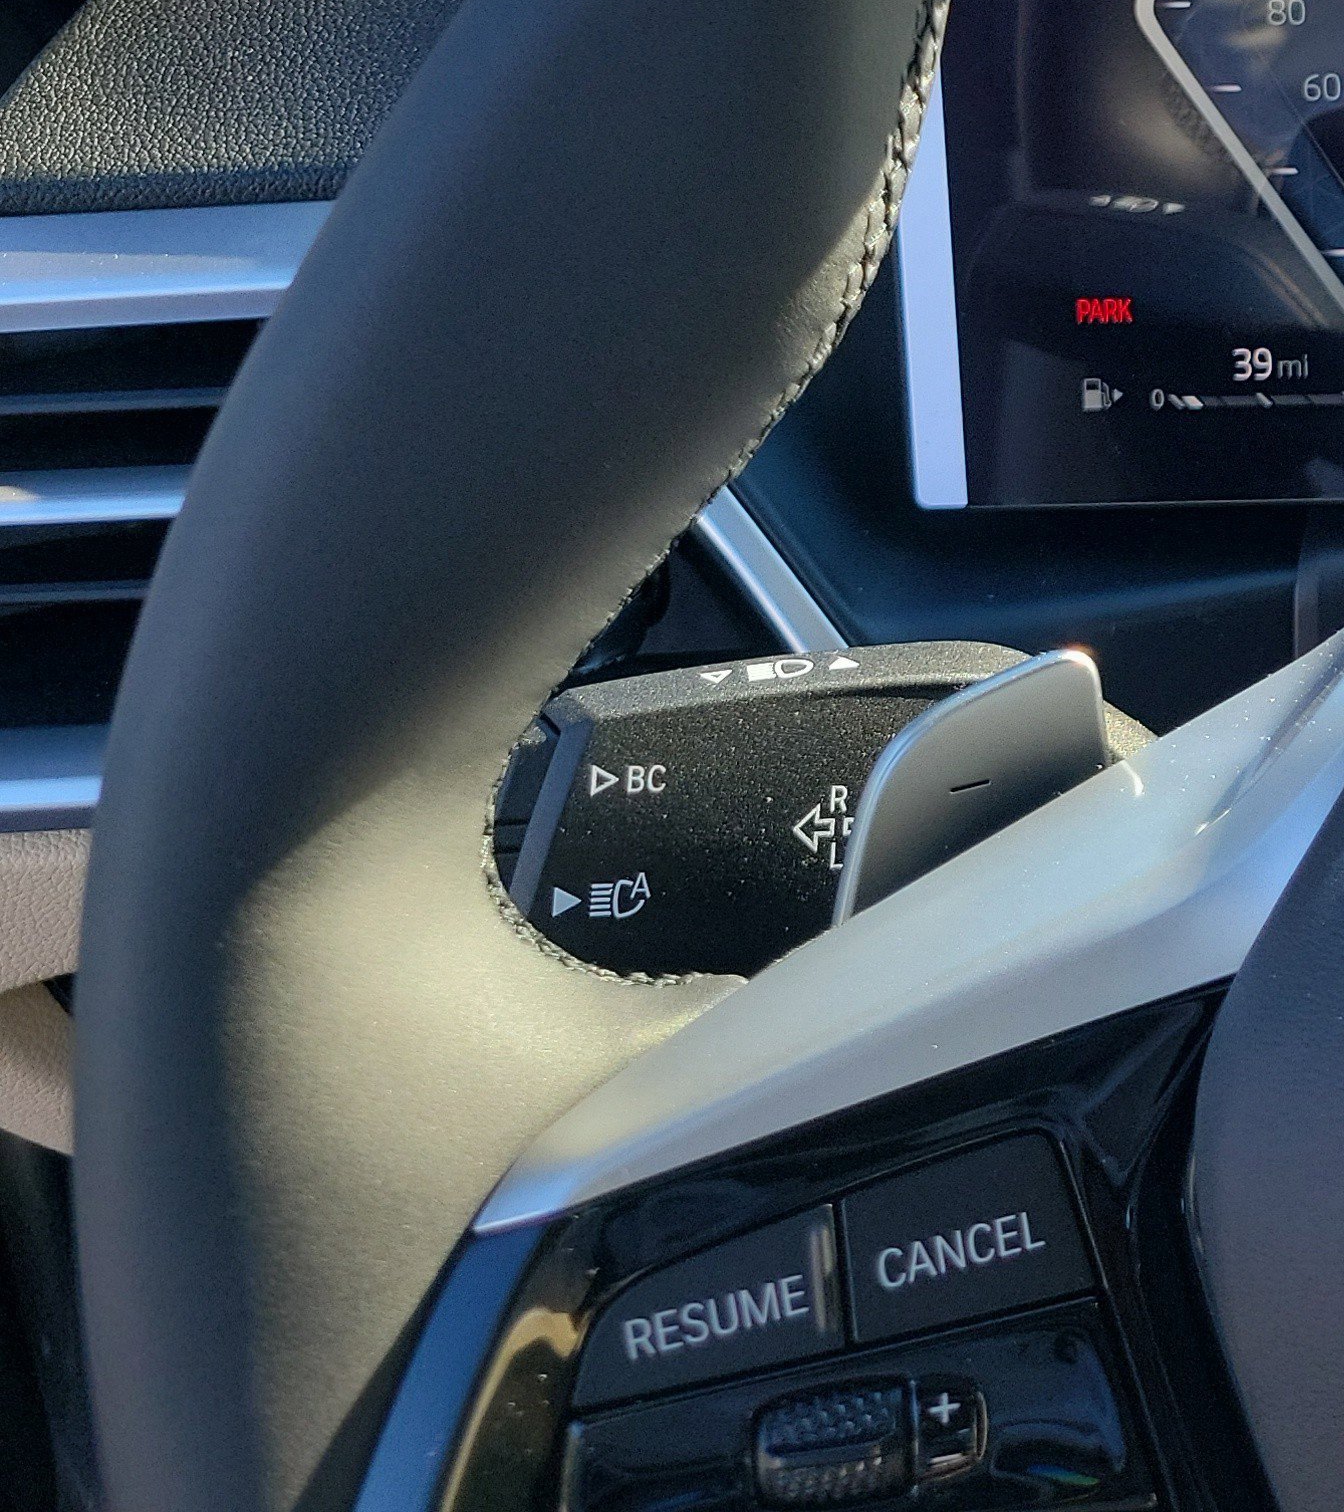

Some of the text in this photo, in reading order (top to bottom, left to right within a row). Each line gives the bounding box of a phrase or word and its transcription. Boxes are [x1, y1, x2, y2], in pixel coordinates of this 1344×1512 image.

[1303, 73, 1342, 102] 60
[1075, 297, 1133, 325] PARK
[1231, 347, 1310, 382] 39 mi
[626, 764, 667, 795] BC
[829, 784, 848, 813] R
[621, 1209, 1046, 1362] RESUME CANCEL
